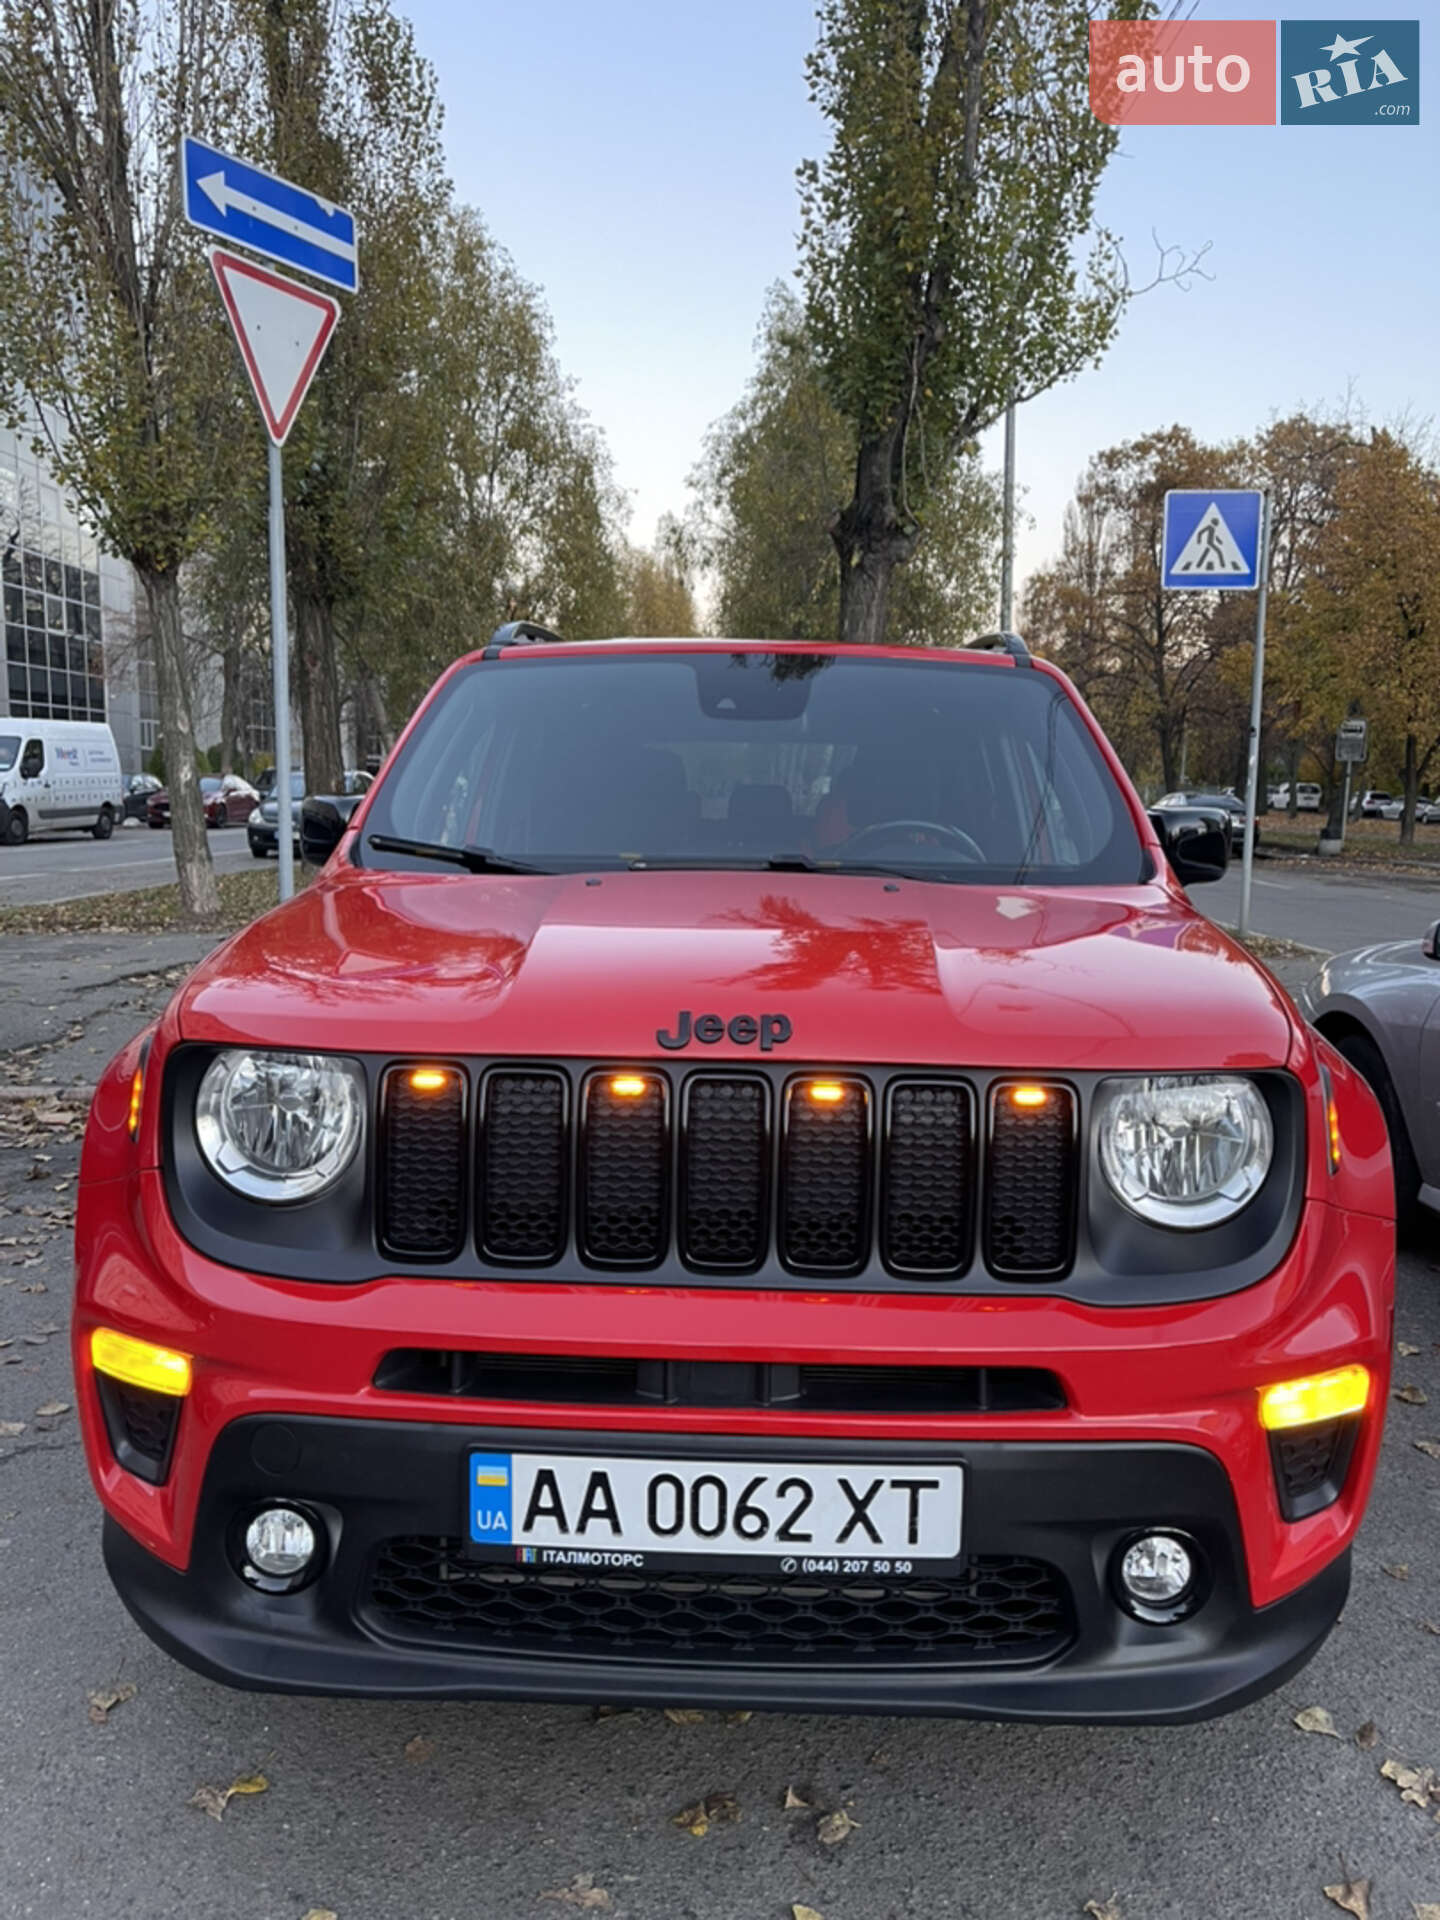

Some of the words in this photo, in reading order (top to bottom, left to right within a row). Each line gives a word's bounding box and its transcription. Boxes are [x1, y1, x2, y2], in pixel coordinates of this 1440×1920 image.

[656, 1010, 793, 1052] Jeep
[522, 1468, 623, 1536] AA
[647, 1473, 814, 1542] 0062
[835, 1478, 940, 1545] XT
[476, 1510, 508, 1531] UA
[542, 1550, 644, 1567] ІТАЛМОТОРС
[802, 1558, 839, 1573] (044)
[843, 1560, 869, 1573] 207
[873, 1561, 891, 1573] 50
[895, 1561, 912, 1574] 50
